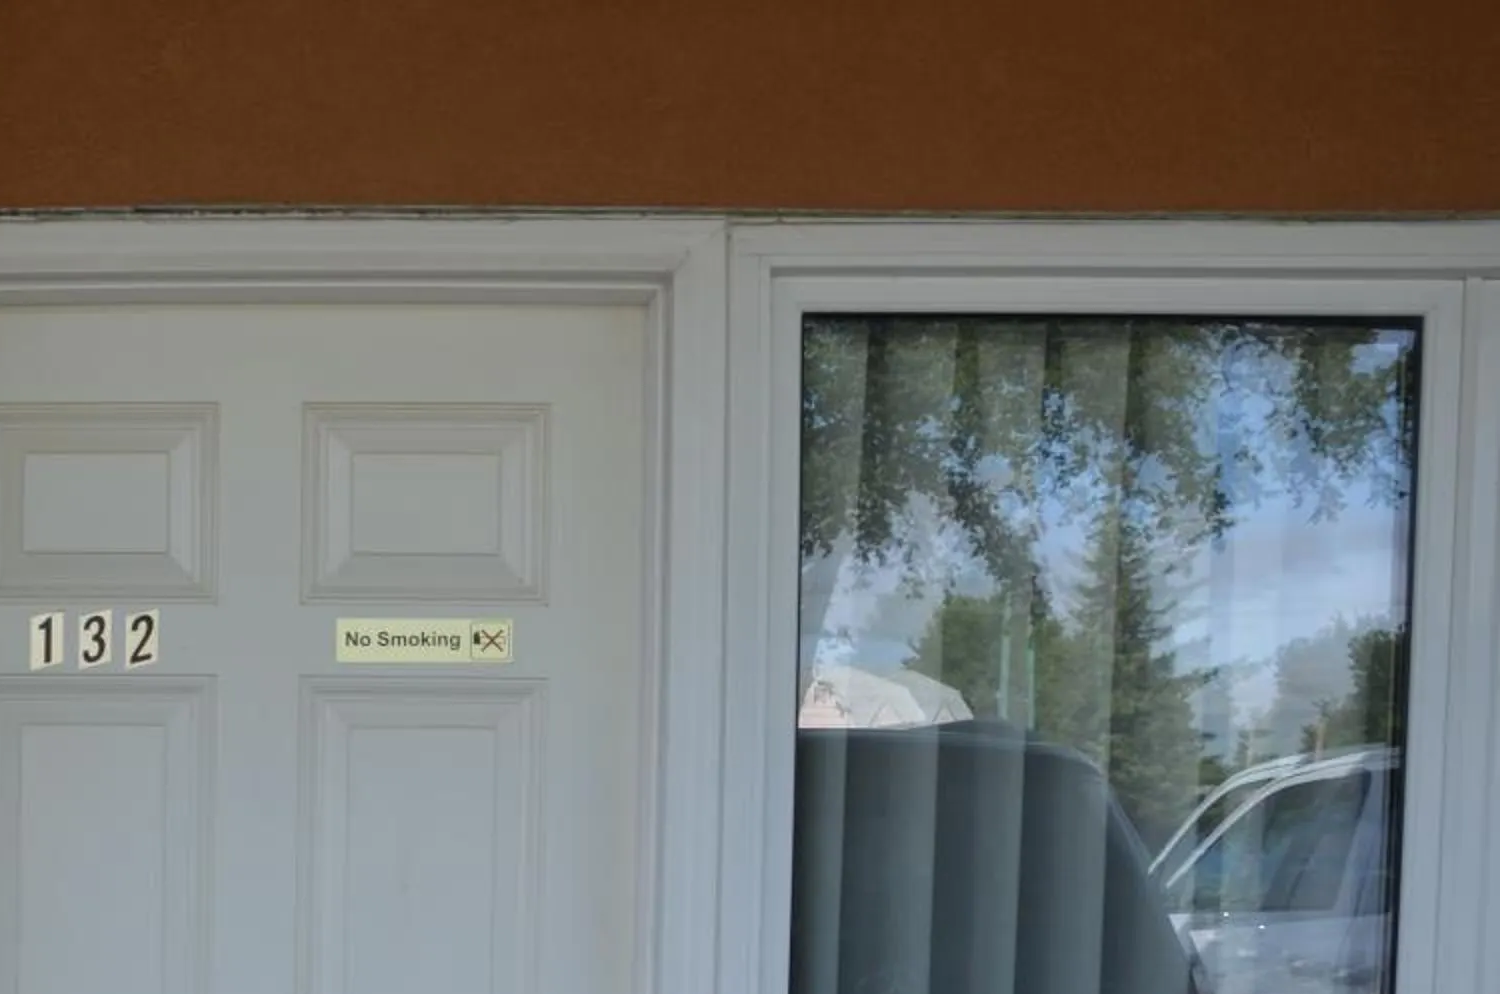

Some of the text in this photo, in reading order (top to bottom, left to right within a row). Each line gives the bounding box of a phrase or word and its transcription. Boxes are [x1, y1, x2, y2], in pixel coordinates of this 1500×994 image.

[37, 614, 154, 664] 132
[345, 630, 461, 651] No Smoking
